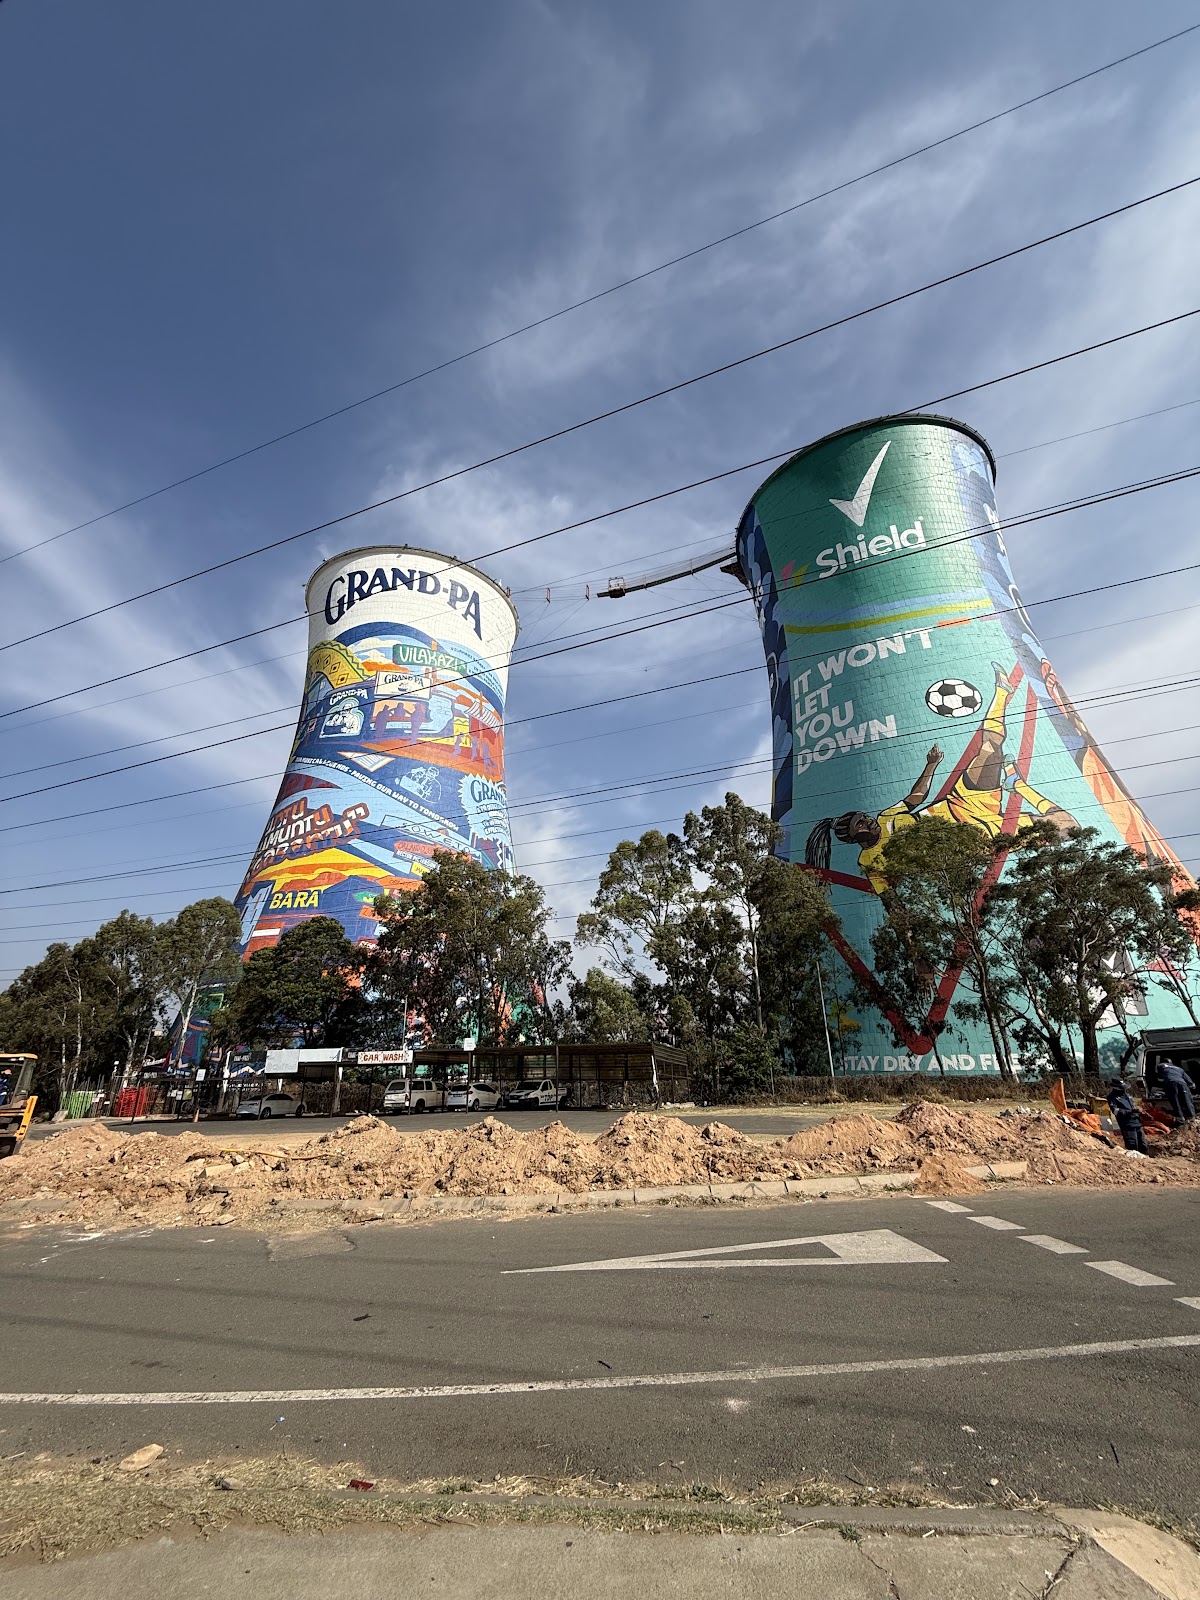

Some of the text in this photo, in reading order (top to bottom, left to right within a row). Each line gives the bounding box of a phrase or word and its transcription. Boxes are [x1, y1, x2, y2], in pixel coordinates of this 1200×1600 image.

[816, 521, 926, 578] Shield
[324, 567, 483, 641] GRAND-PA
[793, 625, 934, 699] IT WON'T
[329, 688, 369, 705] GRAND-PA
[795, 682, 832, 724] LET
[795, 700, 854, 749] YOU
[796, 714, 898, 775] DOWN
[350, 769, 377, 787] PAVING
[376, 782, 393, 795] OUR
[392, 790, 409, 804] WAY
[408, 799, 419, 810] TO
[269, 890, 319, 909] BARA
[363, 1053, 379, 1062] CAR
[382, 1053, 404, 1061] WASH
[840, 1055, 879, 1071] STAY
[884, 1055, 923, 1071] DRY
[927, 1054, 976, 1071] AND
